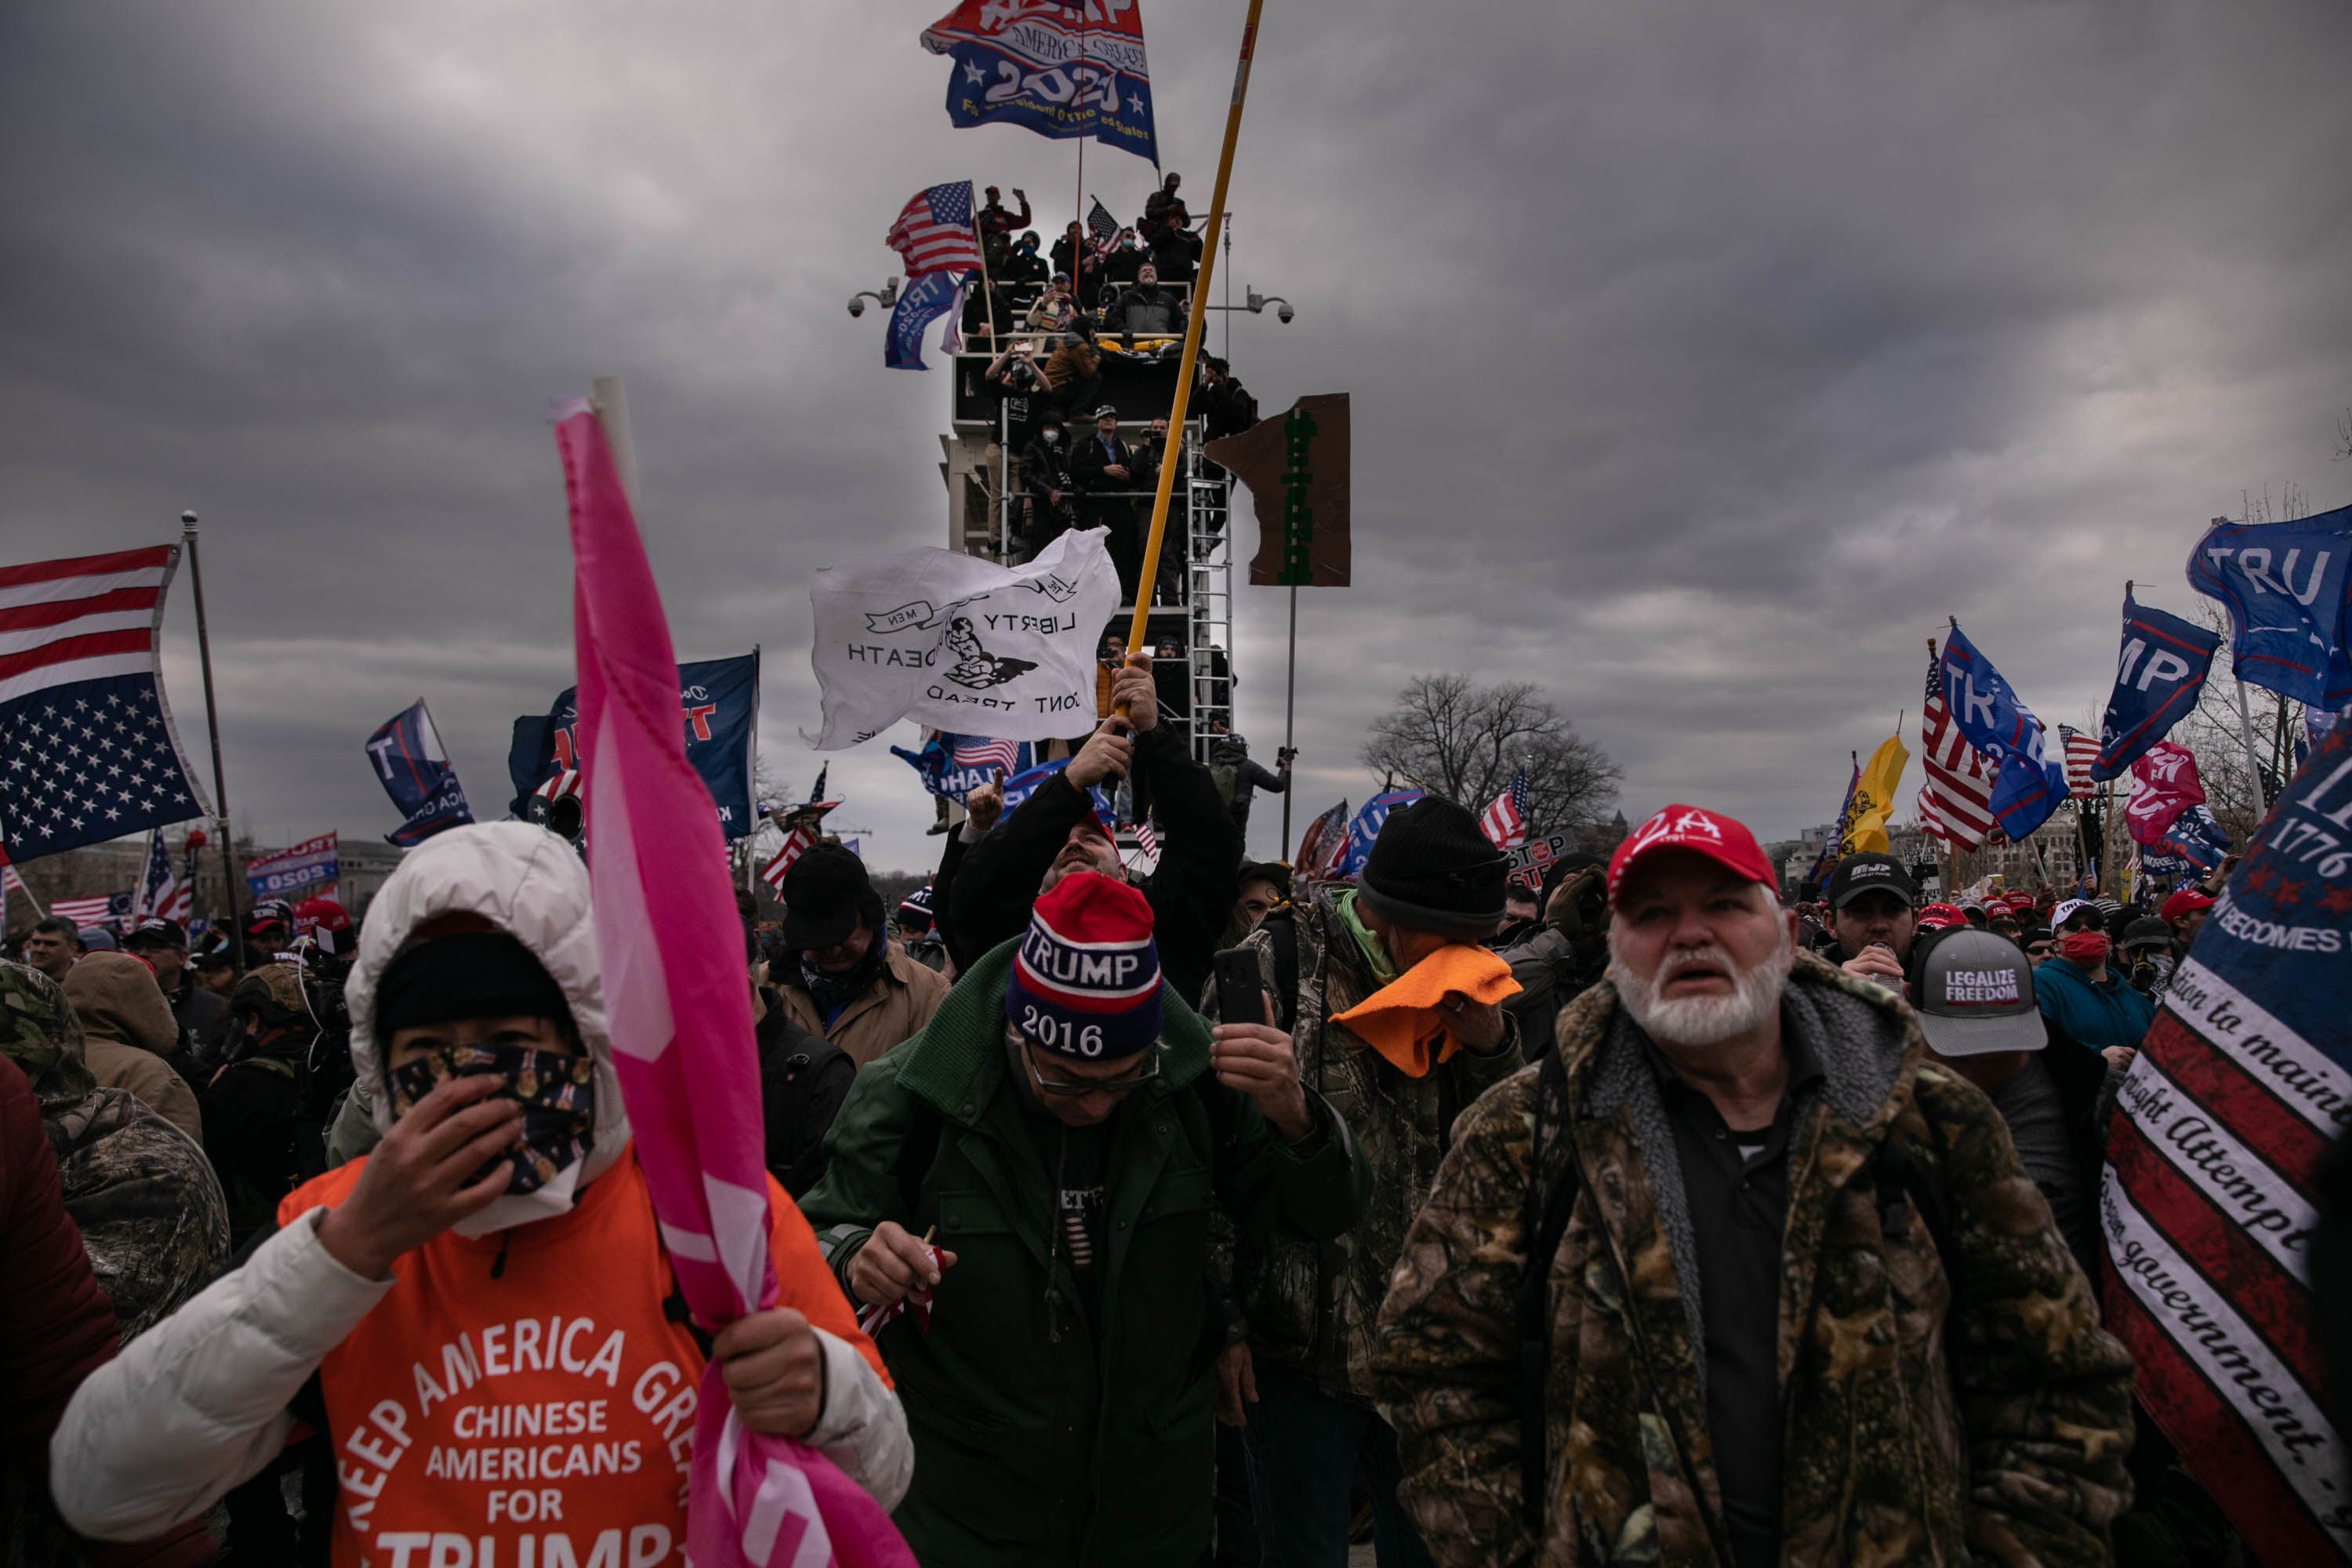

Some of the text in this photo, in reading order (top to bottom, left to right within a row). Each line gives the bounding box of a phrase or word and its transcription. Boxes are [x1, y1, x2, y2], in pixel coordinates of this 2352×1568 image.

[1507, 835, 1565, 870] STOP
[1631, 808, 1722, 855] 2A
[2268, 816, 2352, 879] 1776
[1024, 920, 1138, 985] TRUMP
[2218, 904, 2343, 953] BECOMES
[1946, 969, 2016, 985] LEGALIZE
[1946, 985, 2019, 1002] FREEDOM
[1022, 1004, 1103, 1057] 2016
[2166, 1116, 2318, 1252] Attempt
[412, 1316, 626, 1417] AMERICA
[2118, 1240, 2328, 1466] government.
[452, 1399, 608, 1439] CHINESE
[424, 1440, 642, 1482] AMERICANS
[487, 1488, 564, 1524] FOR
